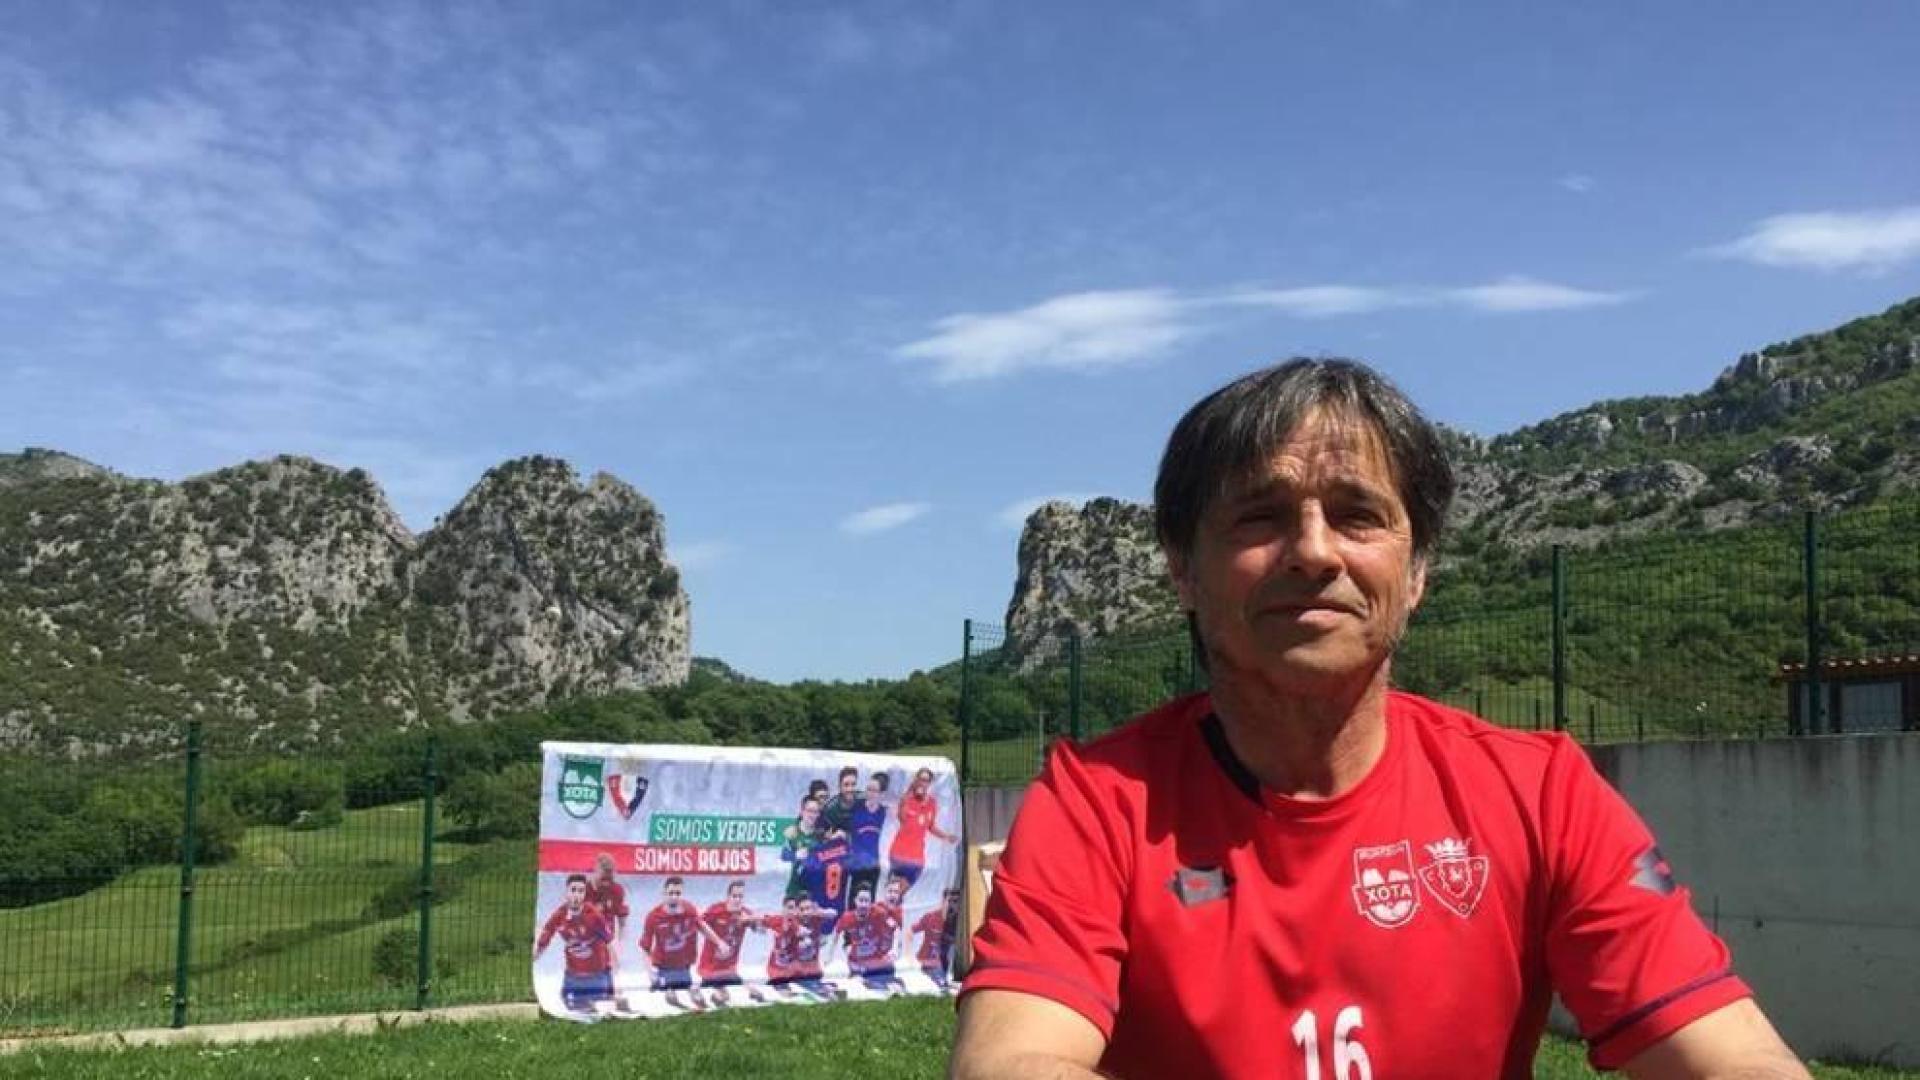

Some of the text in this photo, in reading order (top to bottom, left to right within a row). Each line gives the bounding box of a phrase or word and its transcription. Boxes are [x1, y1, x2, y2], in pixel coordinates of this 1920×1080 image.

[655, 818, 776, 842] SOMOS VERDES
[635, 847, 751, 871] SOMOS ROJOS
[1364, 882, 1413, 902] XOTA
[1291, 1006, 1373, 1080] 16
